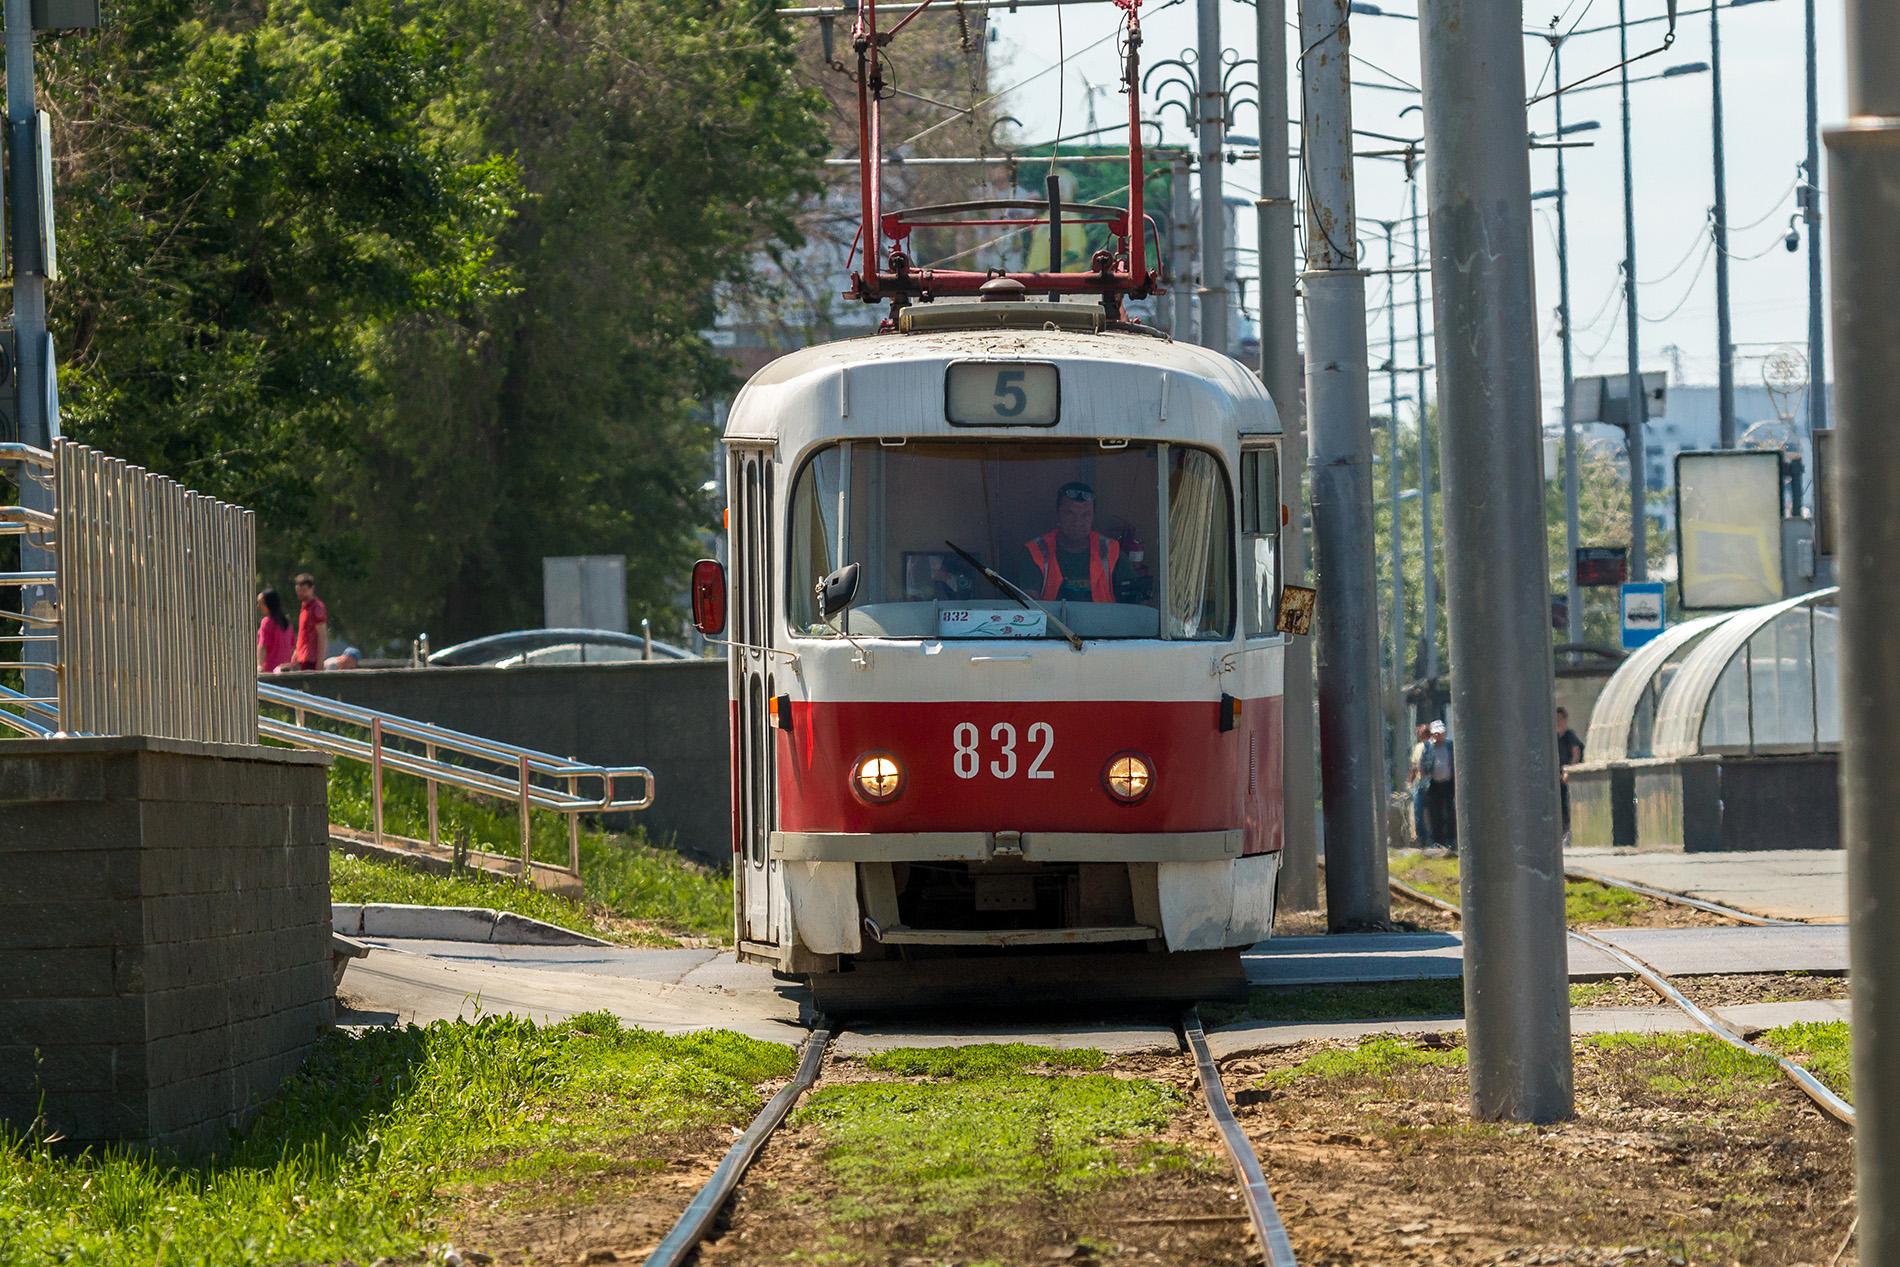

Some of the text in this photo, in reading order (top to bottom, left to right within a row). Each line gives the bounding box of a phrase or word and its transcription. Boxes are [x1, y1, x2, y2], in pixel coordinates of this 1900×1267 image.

[993, 371, 1027, 417] 5
[943, 611, 969, 622] 832
[953, 722, 1054, 779] 832
